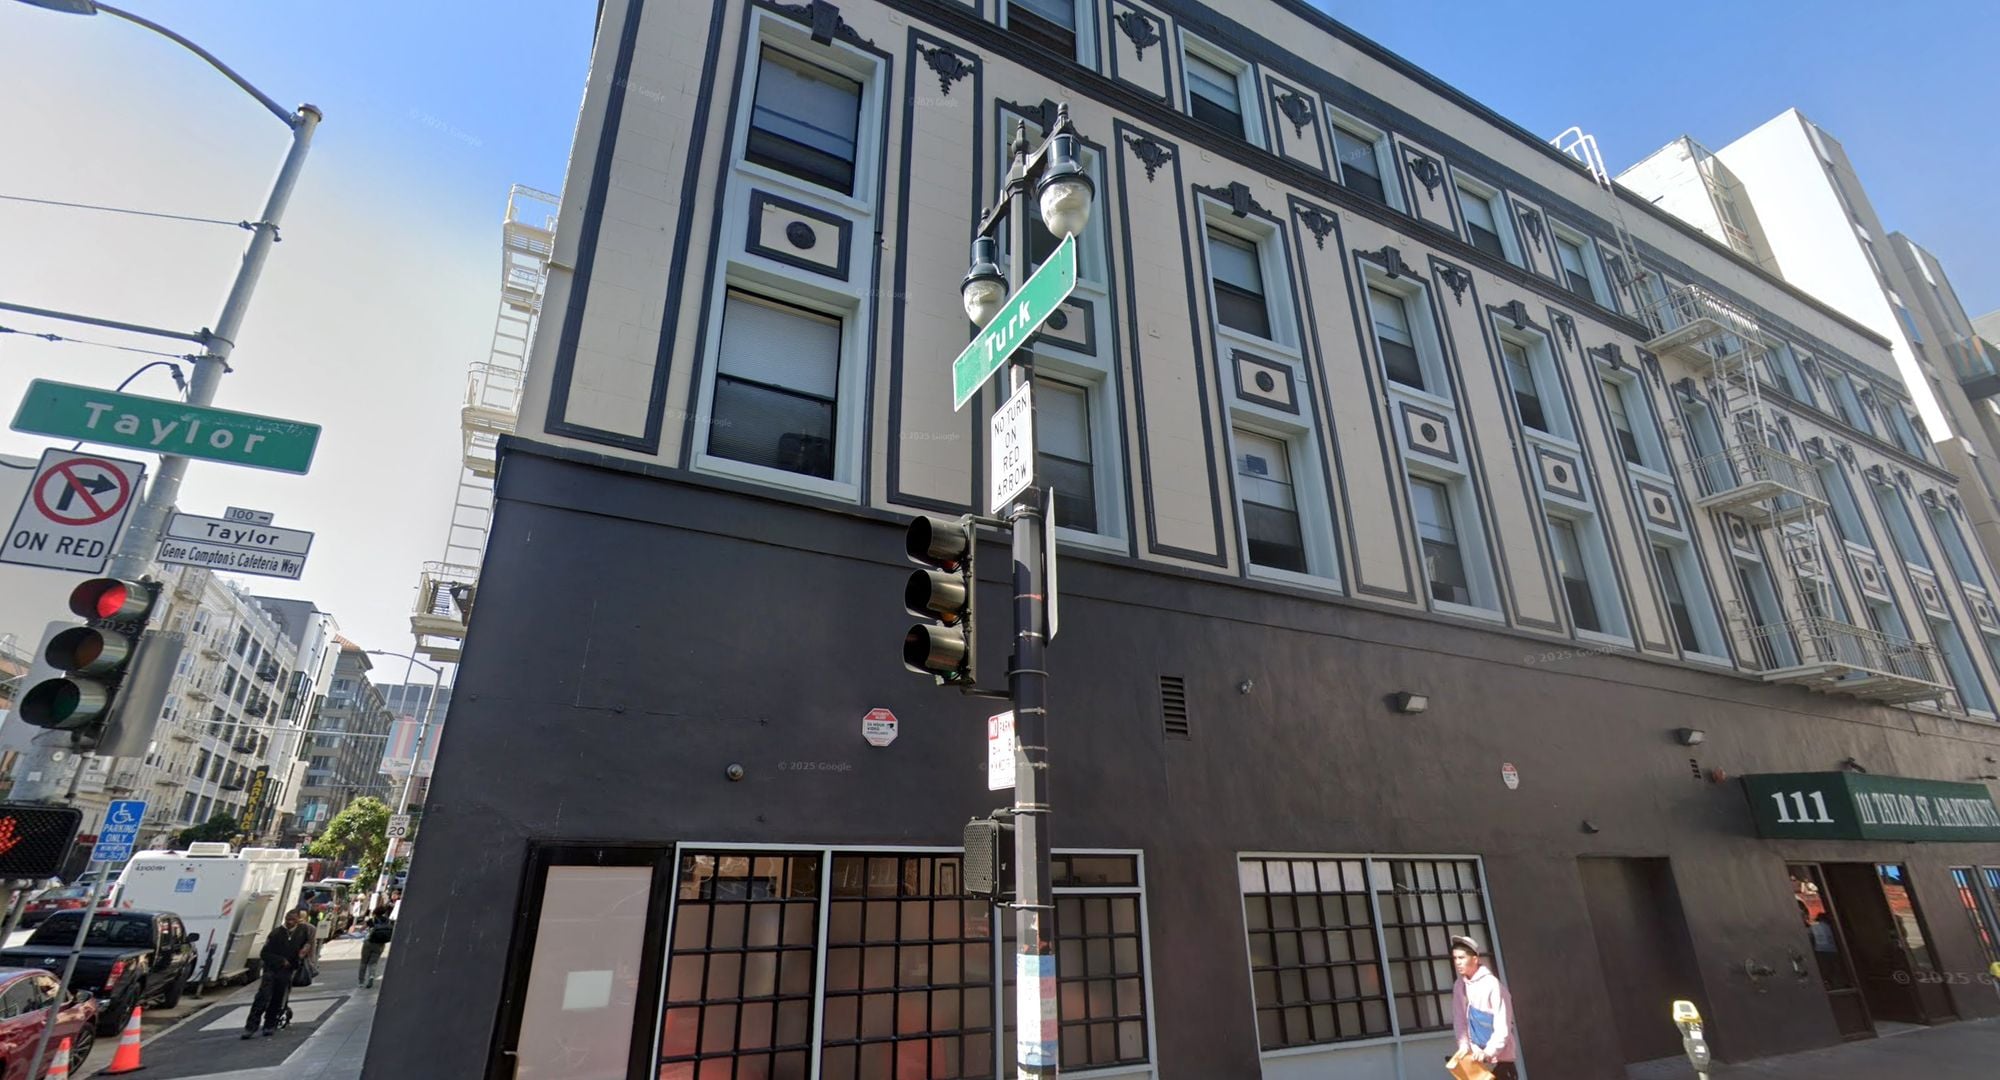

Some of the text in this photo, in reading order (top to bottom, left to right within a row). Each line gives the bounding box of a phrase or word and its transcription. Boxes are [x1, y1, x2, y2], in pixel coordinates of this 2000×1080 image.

[985, 300, 1031, 361] Turk
[84, 402, 266, 452] Taylor
[994, 393, 1027, 438] NO TURN
[1004, 426, 1017, 448] ON
[1003, 446, 1020, 471] RED
[997, 463, 1027, 498] ARROW
[231, 509, 254, 521] 100
[13, 530, 104, 558] ON RED
[206, 522, 279, 546] Taylor
[161, 543, 301, 578] Gene Compton's Cafeteria Way
[240, 770, 266, 831] PARKING
[1771, 791, 1835, 823] 111
[1855, 792, 1877, 824] 111
[1872, 793, 1921, 825] TAYLOR
[103, 823, 137, 834] PARKING
[105, 833, 129, 843] ONLY
[388, 826, 405, 836] 20
